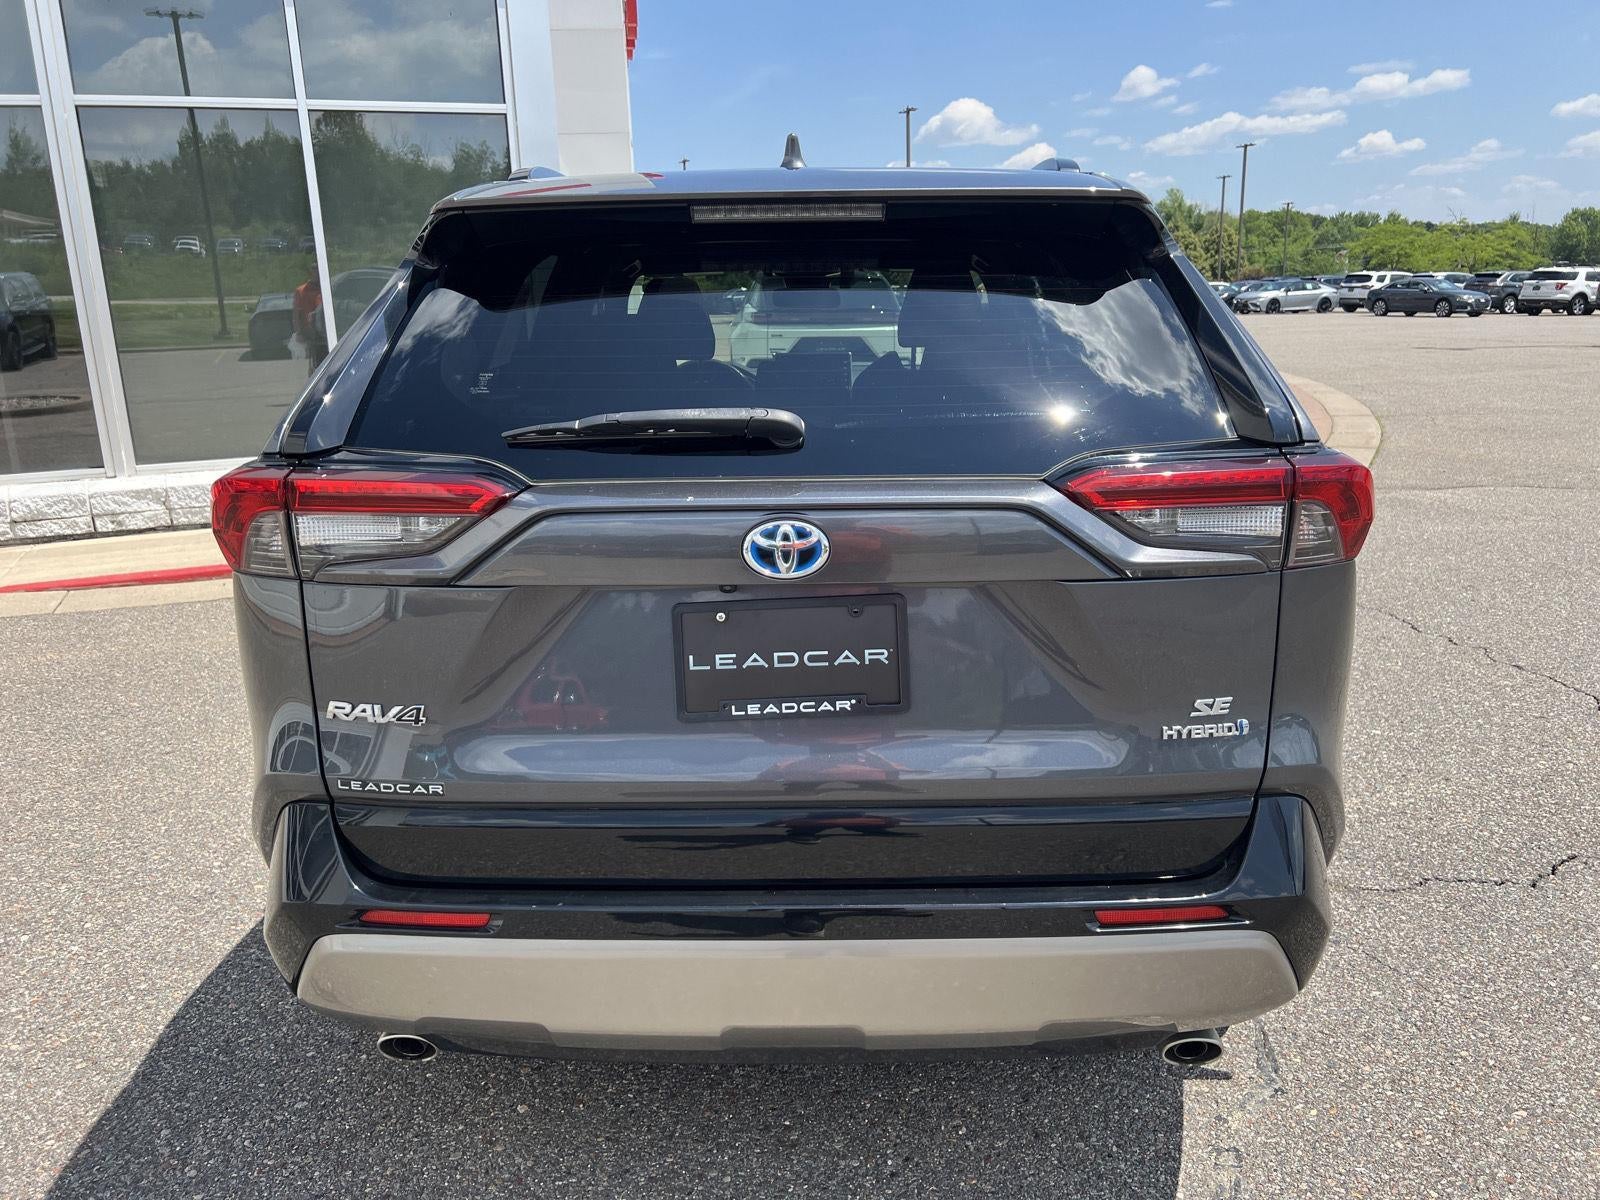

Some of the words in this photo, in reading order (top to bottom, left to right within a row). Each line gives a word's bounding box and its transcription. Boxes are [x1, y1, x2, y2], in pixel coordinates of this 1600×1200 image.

[688, 649, 889, 671] LEADCAR
[326, 700, 427, 727] RAV4
[731, 701, 852, 716] LEADCAR
[1190, 696, 1234, 717] SE
[1162, 722, 1238, 740] HYBRID
[337, 779, 444, 795] LEADCAR
